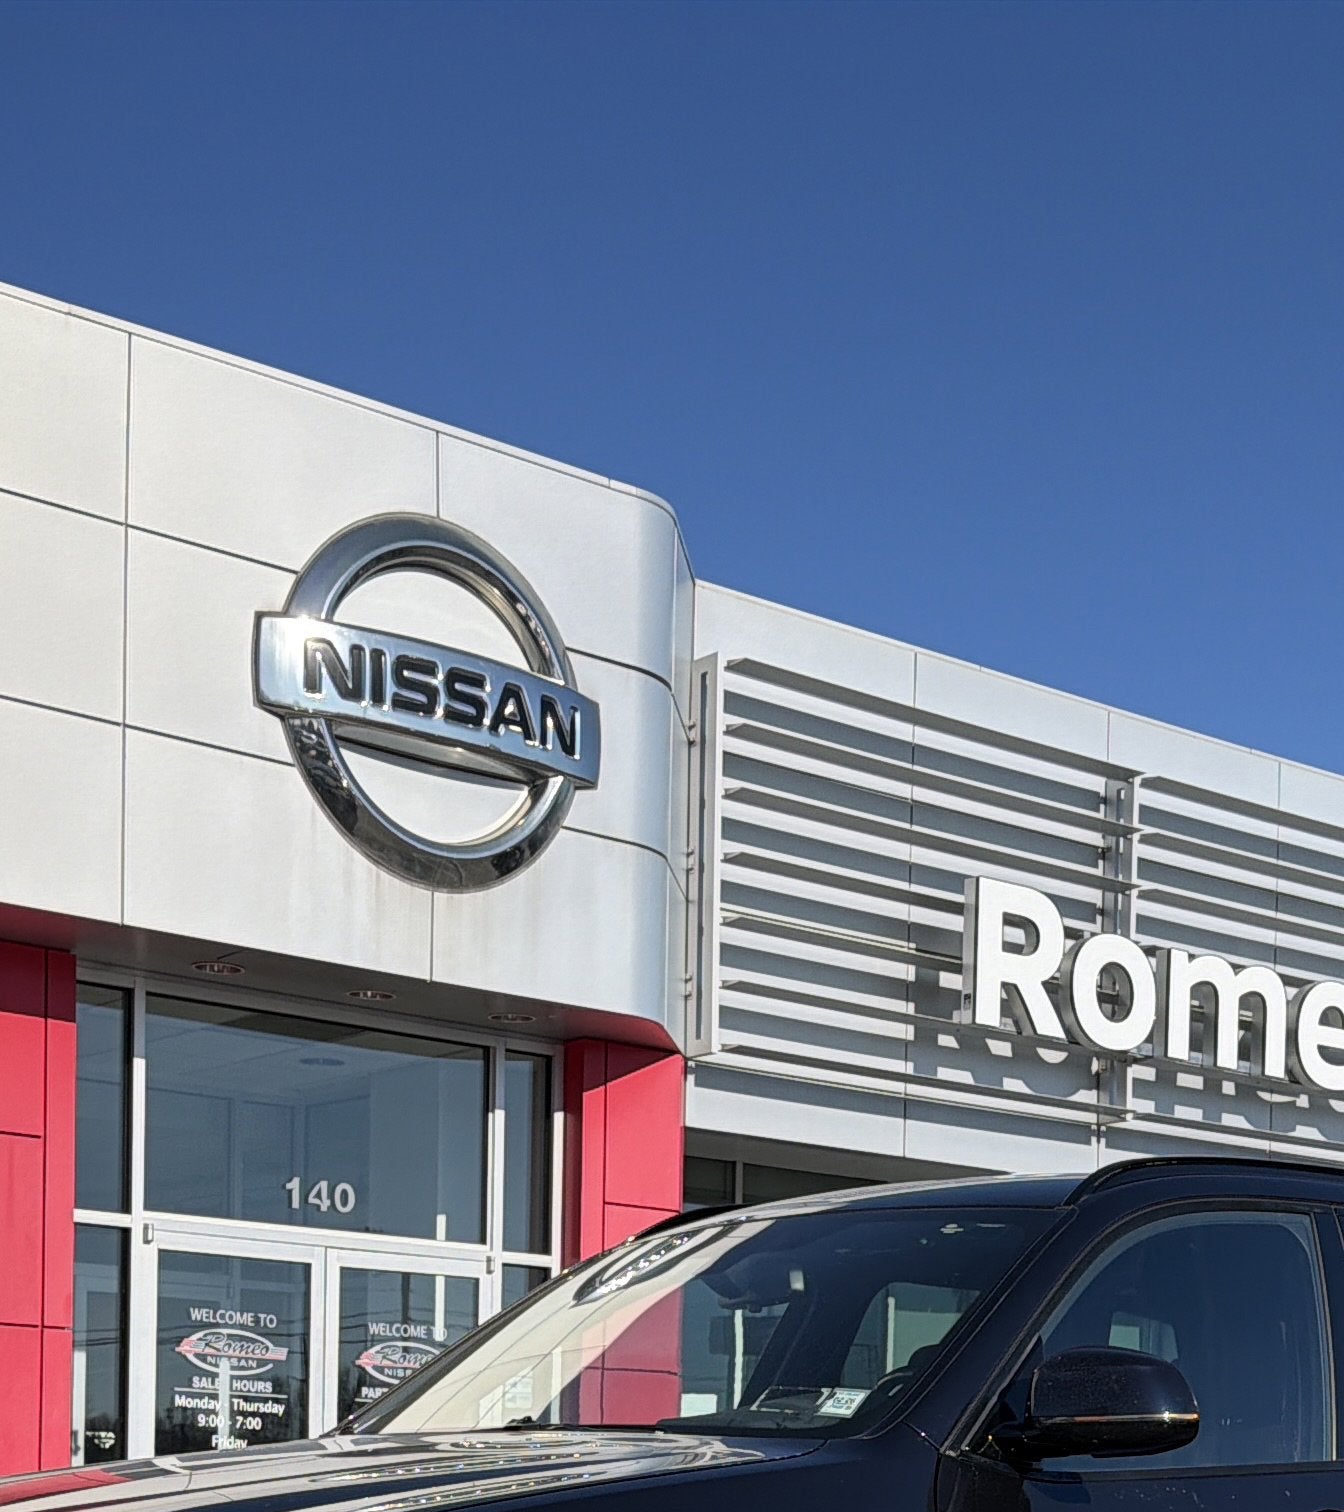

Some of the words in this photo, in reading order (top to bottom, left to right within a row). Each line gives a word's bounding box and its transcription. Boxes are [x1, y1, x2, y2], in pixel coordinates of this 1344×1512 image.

[303, 636, 582, 761] NISSAN
[285, 1176, 356, 1213] 140
[189, 1307, 254, 1327] WELCOME
[257, 1314, 277, 1329] TO
[367, 1322, 428, 1339] WELCOME
[201, 1331, 270, 1357] Romeo
[206, 1356, 257, 1368] NISAN
[192, 1376, 224, 1390] SALE
[232, 1380, 273, 1393] HOURS
[175, 1394, 222, 1413] Monday
[232, 1398, 286, 1417] Thursday
[197, 1413, 225, 1428] 9:00
[235, 1416, 262, 1430] 7:00
